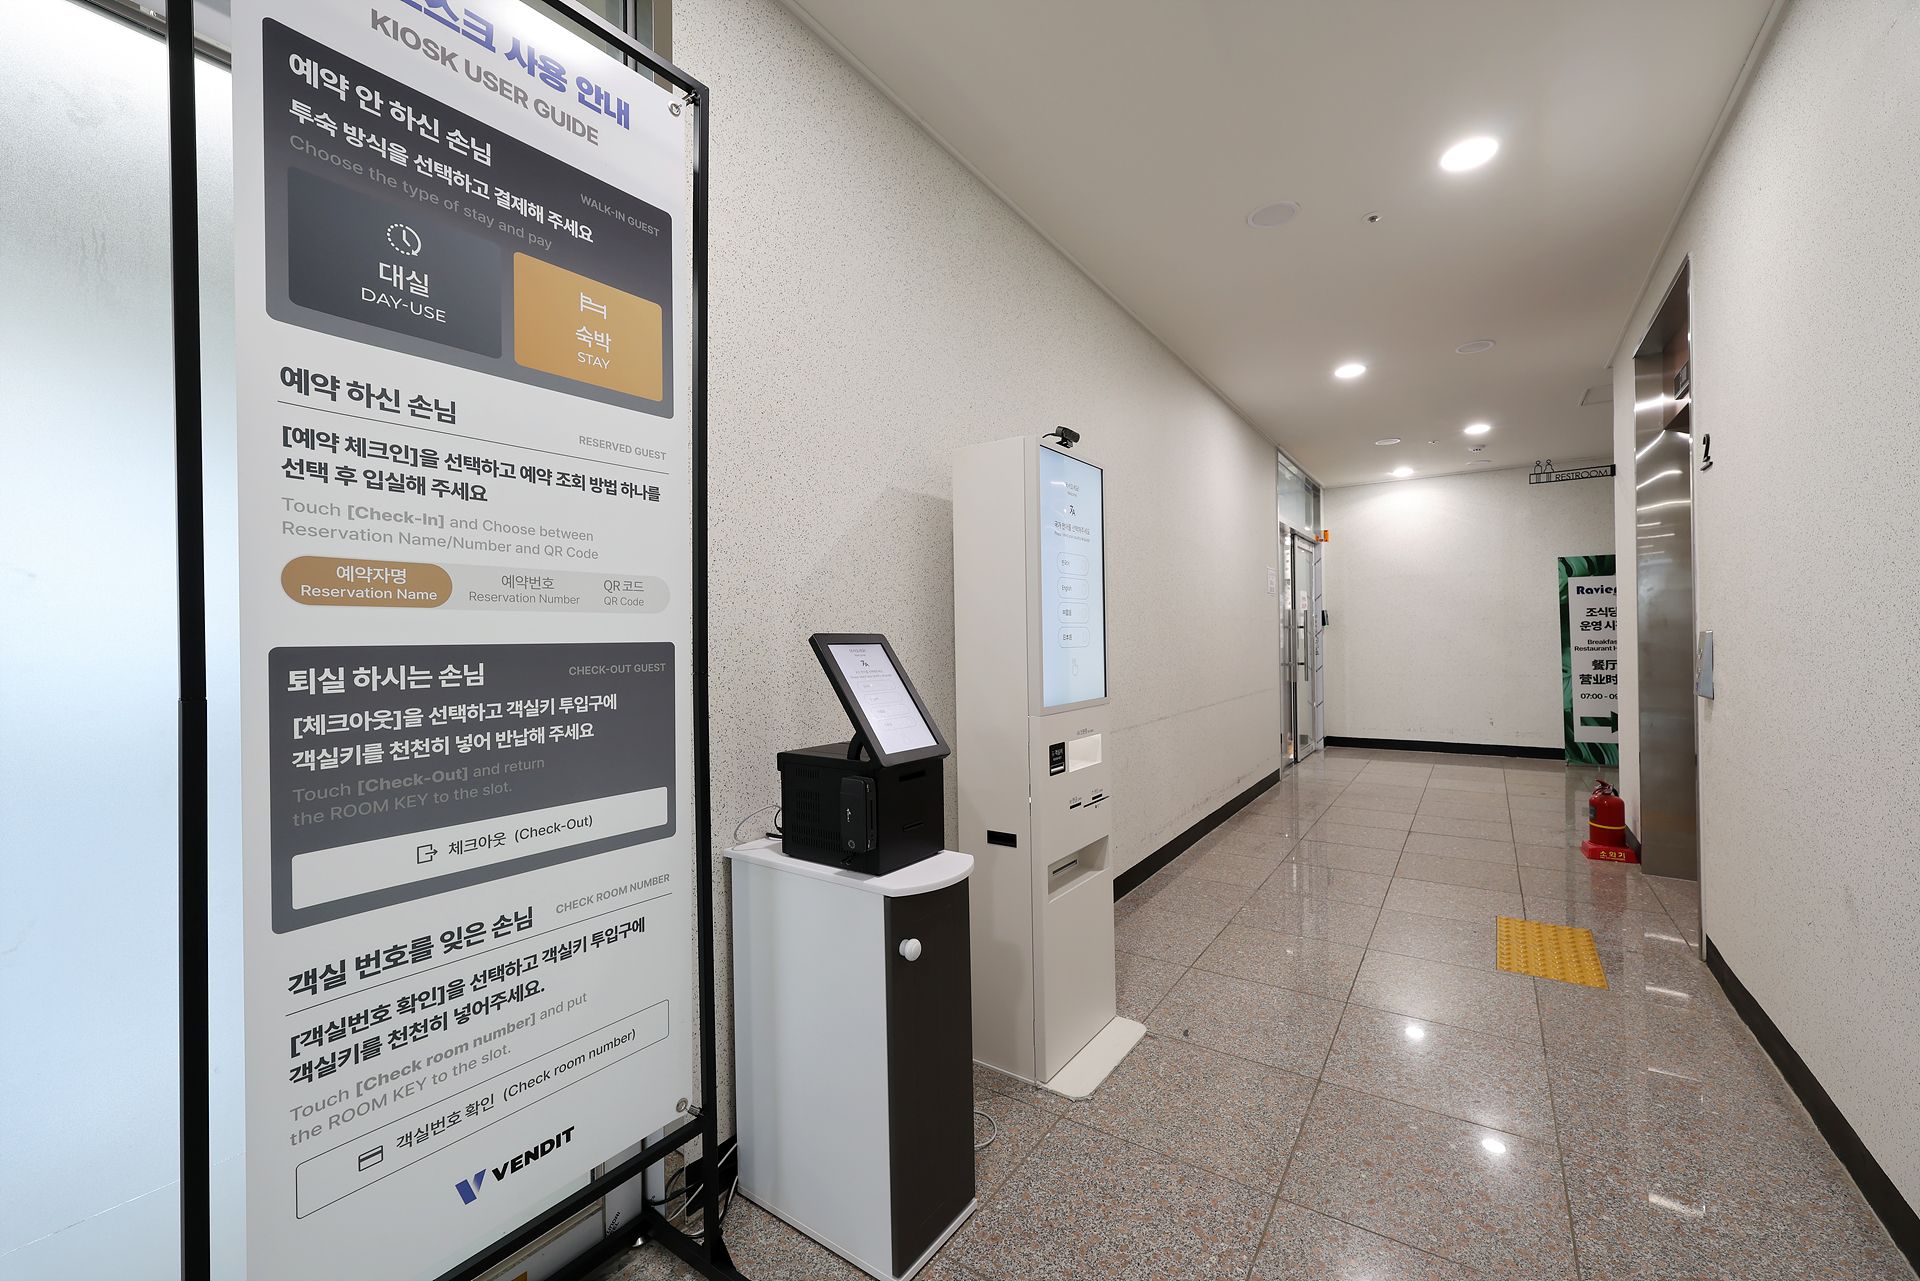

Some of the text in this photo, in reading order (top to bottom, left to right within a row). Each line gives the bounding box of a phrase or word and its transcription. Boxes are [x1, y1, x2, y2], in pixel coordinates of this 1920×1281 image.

[371, 8, 599, 146] KIOSK USER GUIDE
[400, 0, 630, 130] 스크 사용 안내
[289, 54, 491, 167] 예약 안 하신 손님
[289, 99, 594, 243] 투숙 방식을 선택하고 결제해 주세요
[290, 135, 552, 251] Choose the type of stay and pay
[580, 194, 660, 237] WALK-IN GUEST
[379, 262, 429, 298] 대실
[361, 287, 447, 323] DAY-USE
[575, 326, 612, 353] 숙박
[577, 352, 610, 369] STAY
[280, 366, 456, 424] 예약 하신 손님
[282, 426, 661, 503] [예약 체크인]을 선택하고 예약 조회 방법 하나를
[579, 435, 667, 461] RESERVED GUEST
[281, 458, 488, 502] 선택 후 입실해 주세요
[1555, 470, 1608, 481] RESTROOM
[281, 497, 594, 541] Touch [Check-In] and Choose between
[282, 521, 599, 559] Reservation Name/Number and QR Code
[301, 585, 437, 600] Reservation Name
[336, 565, 407, 585] 예약자명
[501, 575, 555, 591] 예약번호
[603, 580, 645, 593] QR 코드
[469, 592, 580, 605] Reservation Number
[603, 597, 644, 607] QR Code
[1580, 620, 1617, 631] 운영 시
[287, 662, 485, 695] 퇴실 하시는 손님
[569, 662, 666, 676] CHECK-OUT GUEST
[293, 693, 617, 740] [체크아웃]을 선택하고 객실키 투입구에
[291, 722, 595, 771] 객실키를 천천히 넣어 반납해 주세요
[292, 759, 545, 803] Touch [Check-Out] and return
[292, 781, 513, 827] the ROOM KEY to the slot.
[448, 815, 593, 855] 체크아웃 (Check-Out)
[556, 873, 670, 914] CHECK ROOM NUMBER
[288, 906, 533, 996] 객실 번호를 잊은 손님
[290, 916, 645, 1059] [객실번호 확인]을 선택하고 객실키 투입구에
[289, 980, 545, 1084] 객실키를 천천히 넣어주세요.
[289, 993, 588, 1122] Touch [Check room number] and put
[289, 1045, 511, 1146] the ROOM KEY to the slot.
[396, 1029, 636, 1150] 객실번호 확인 (Check room number)
[492, 1126, 575, 1181] VENDIT
